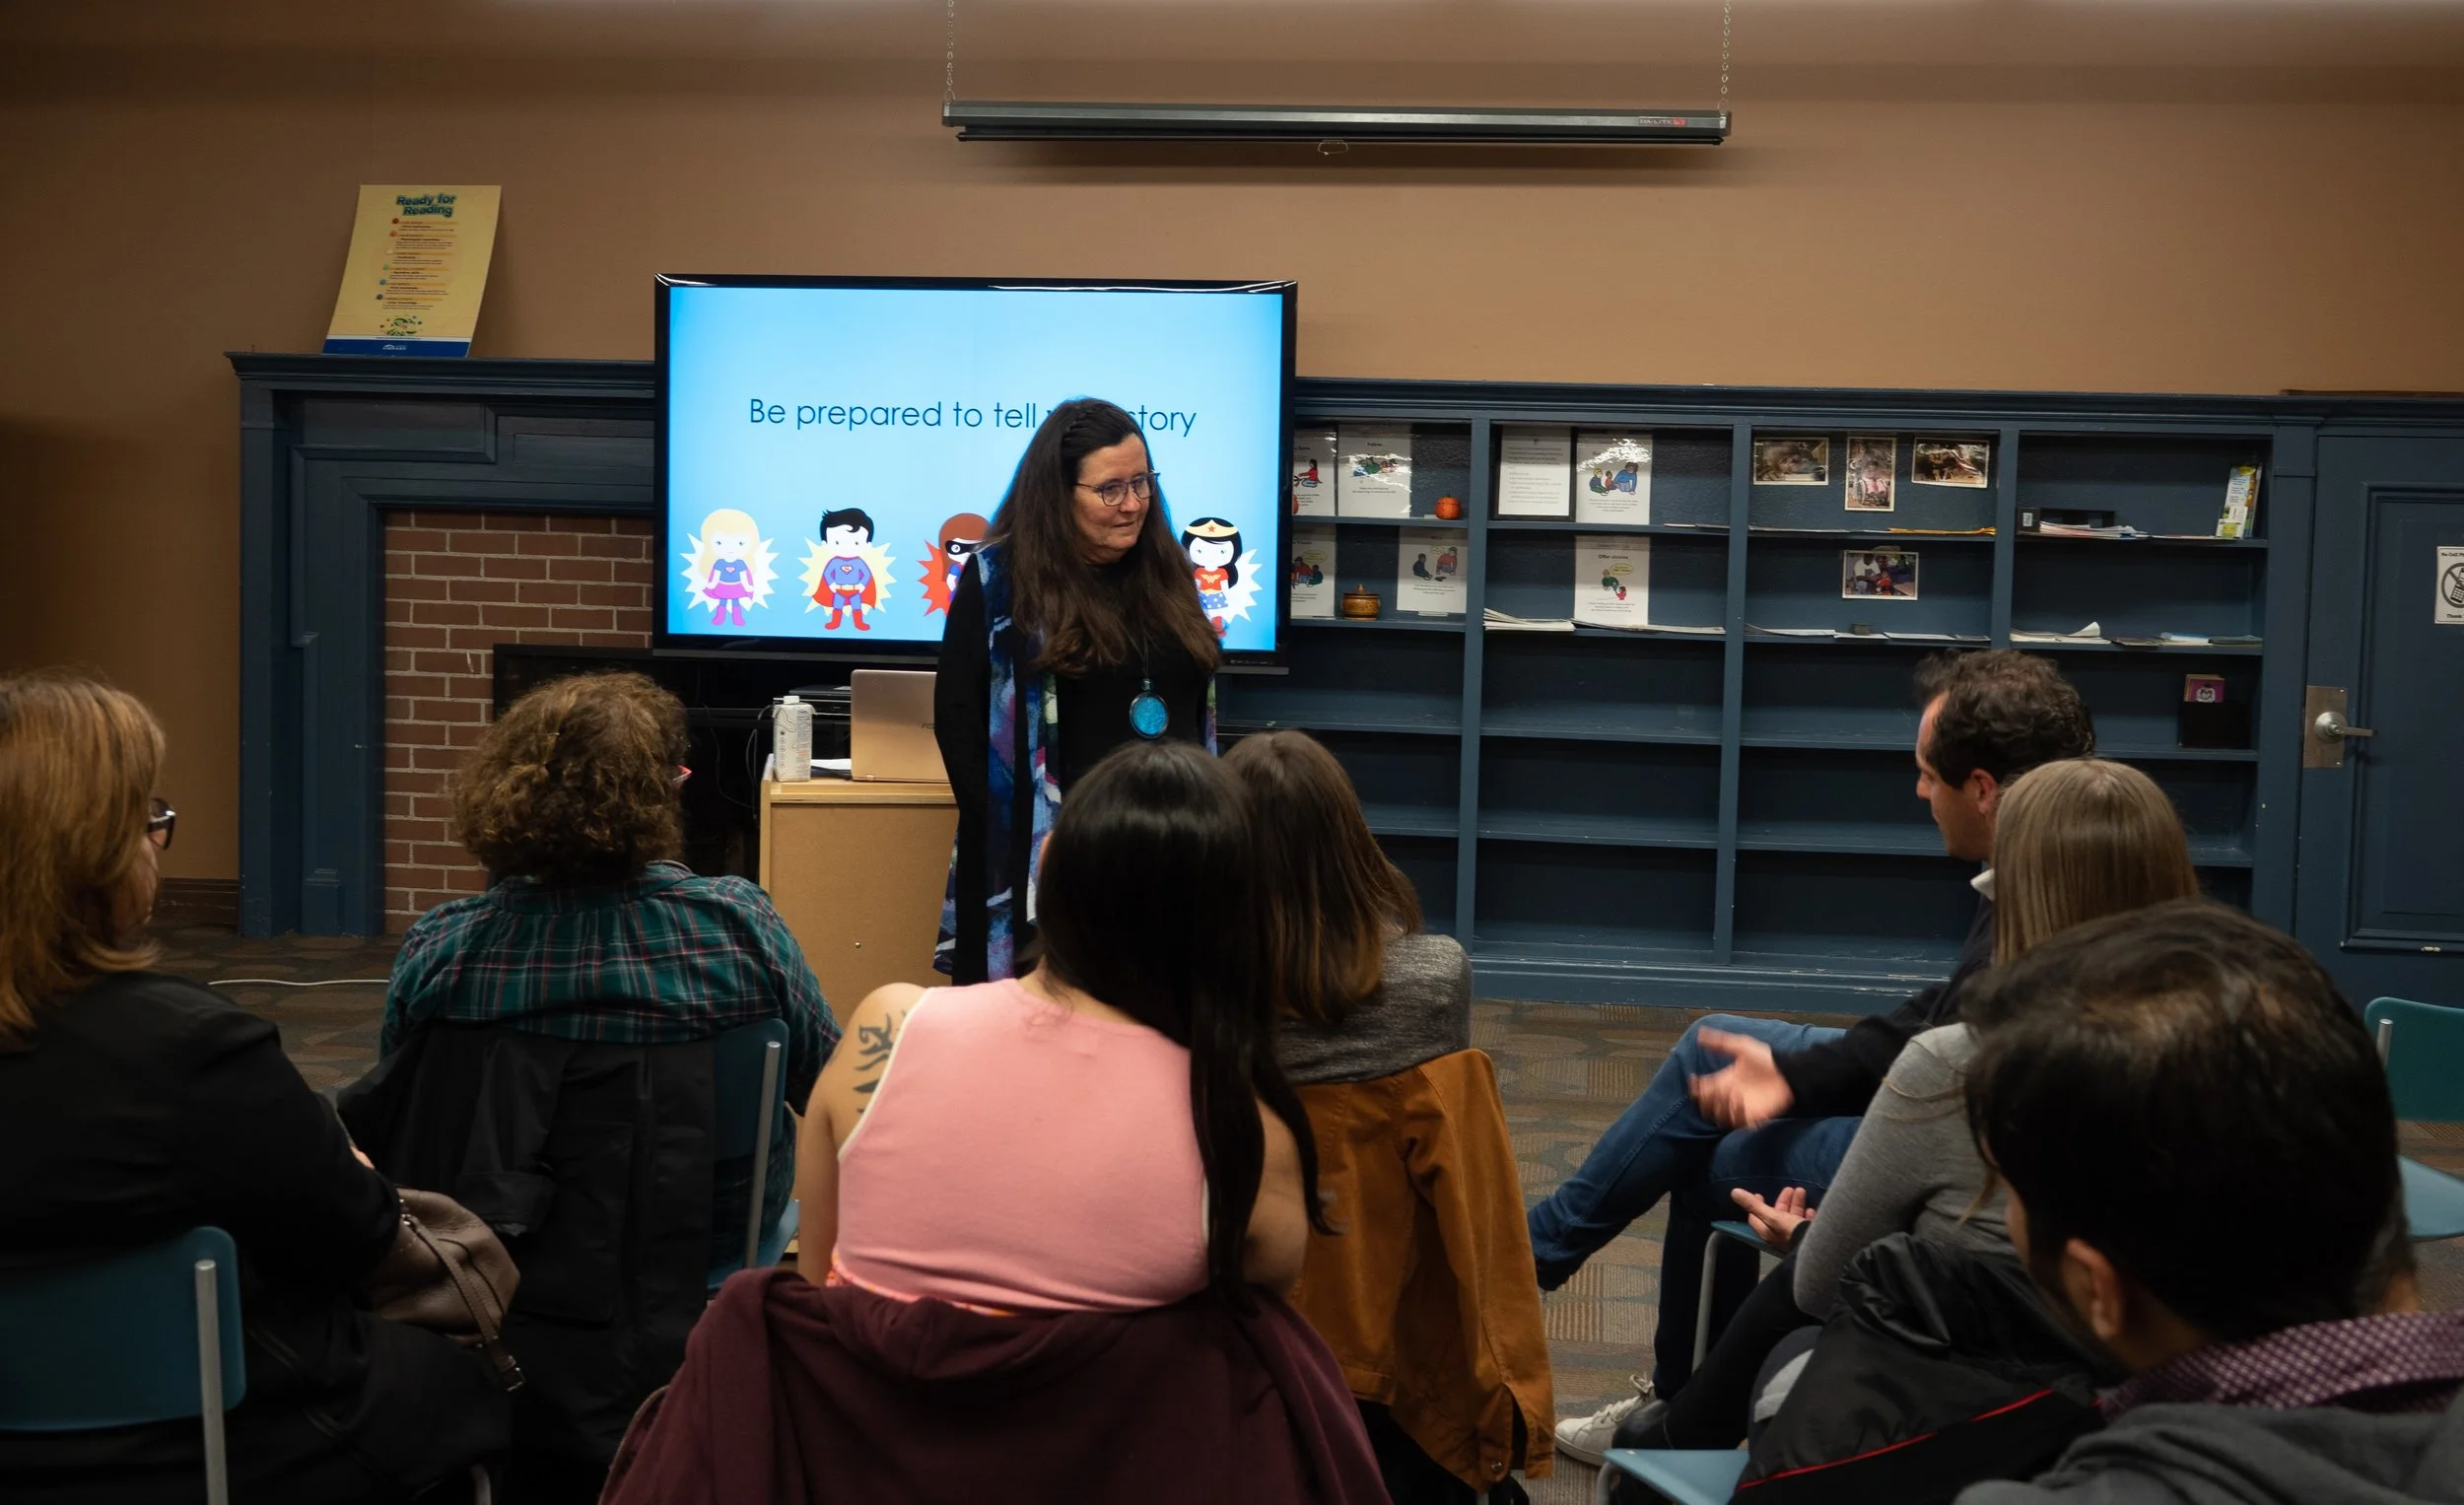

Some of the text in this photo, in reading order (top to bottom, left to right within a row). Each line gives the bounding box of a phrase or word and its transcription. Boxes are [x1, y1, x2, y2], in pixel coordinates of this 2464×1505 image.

[396, 192, 456, 206] Ready for
[402, 206, 453, 218] Reading
[750, 398, 786, 424] Be
[797, 401, 941, 431] prepared
[953, 401, 983, 428] to
[993, 402, 1036, 428] tell
